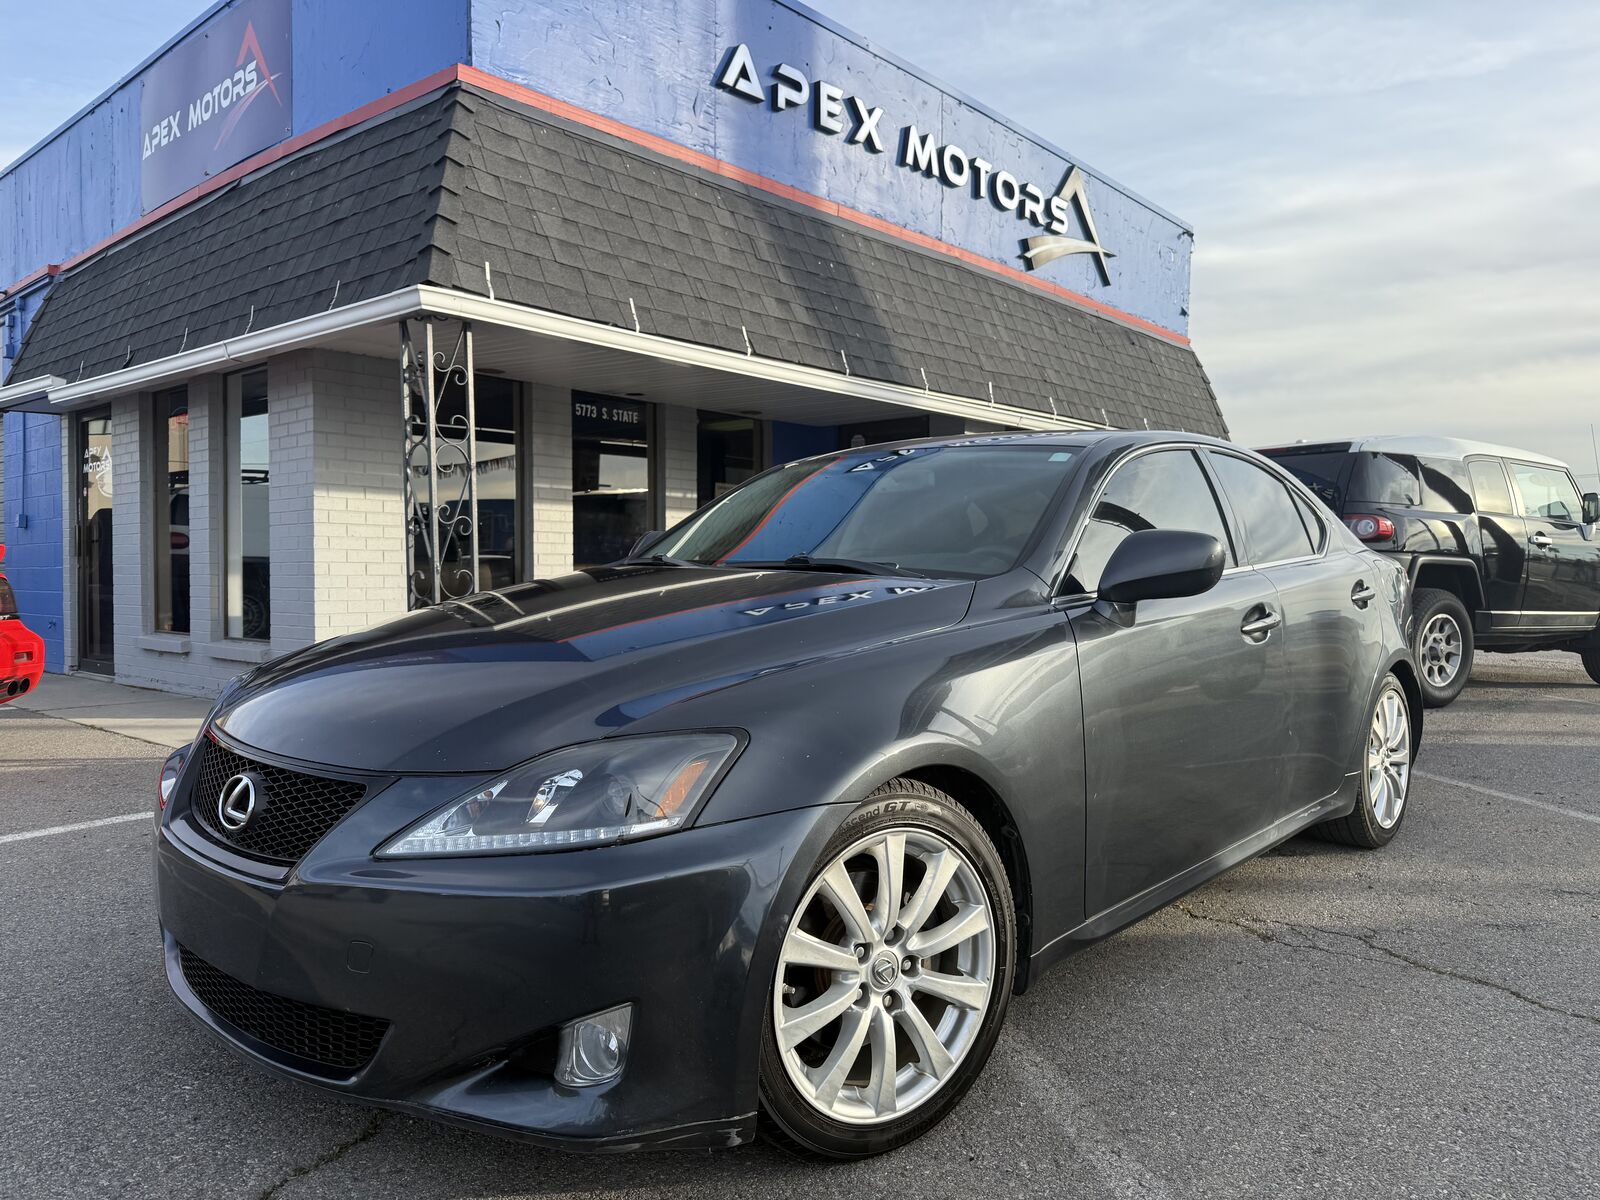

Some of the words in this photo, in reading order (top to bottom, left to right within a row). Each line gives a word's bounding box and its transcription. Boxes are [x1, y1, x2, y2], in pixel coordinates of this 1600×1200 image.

[143, 110, 181, 160] APEX
[188, 60, 257, 131] MOTORS
[719, 43, 884, 152] APEX
[902, 125, 1069, 234] MOTORS
[575, 403, 597, 418] 5773
[601, 407, 610, 420] S.
[612, 409, 639, 423] STATE
[883, 801, 911, 813] GT
